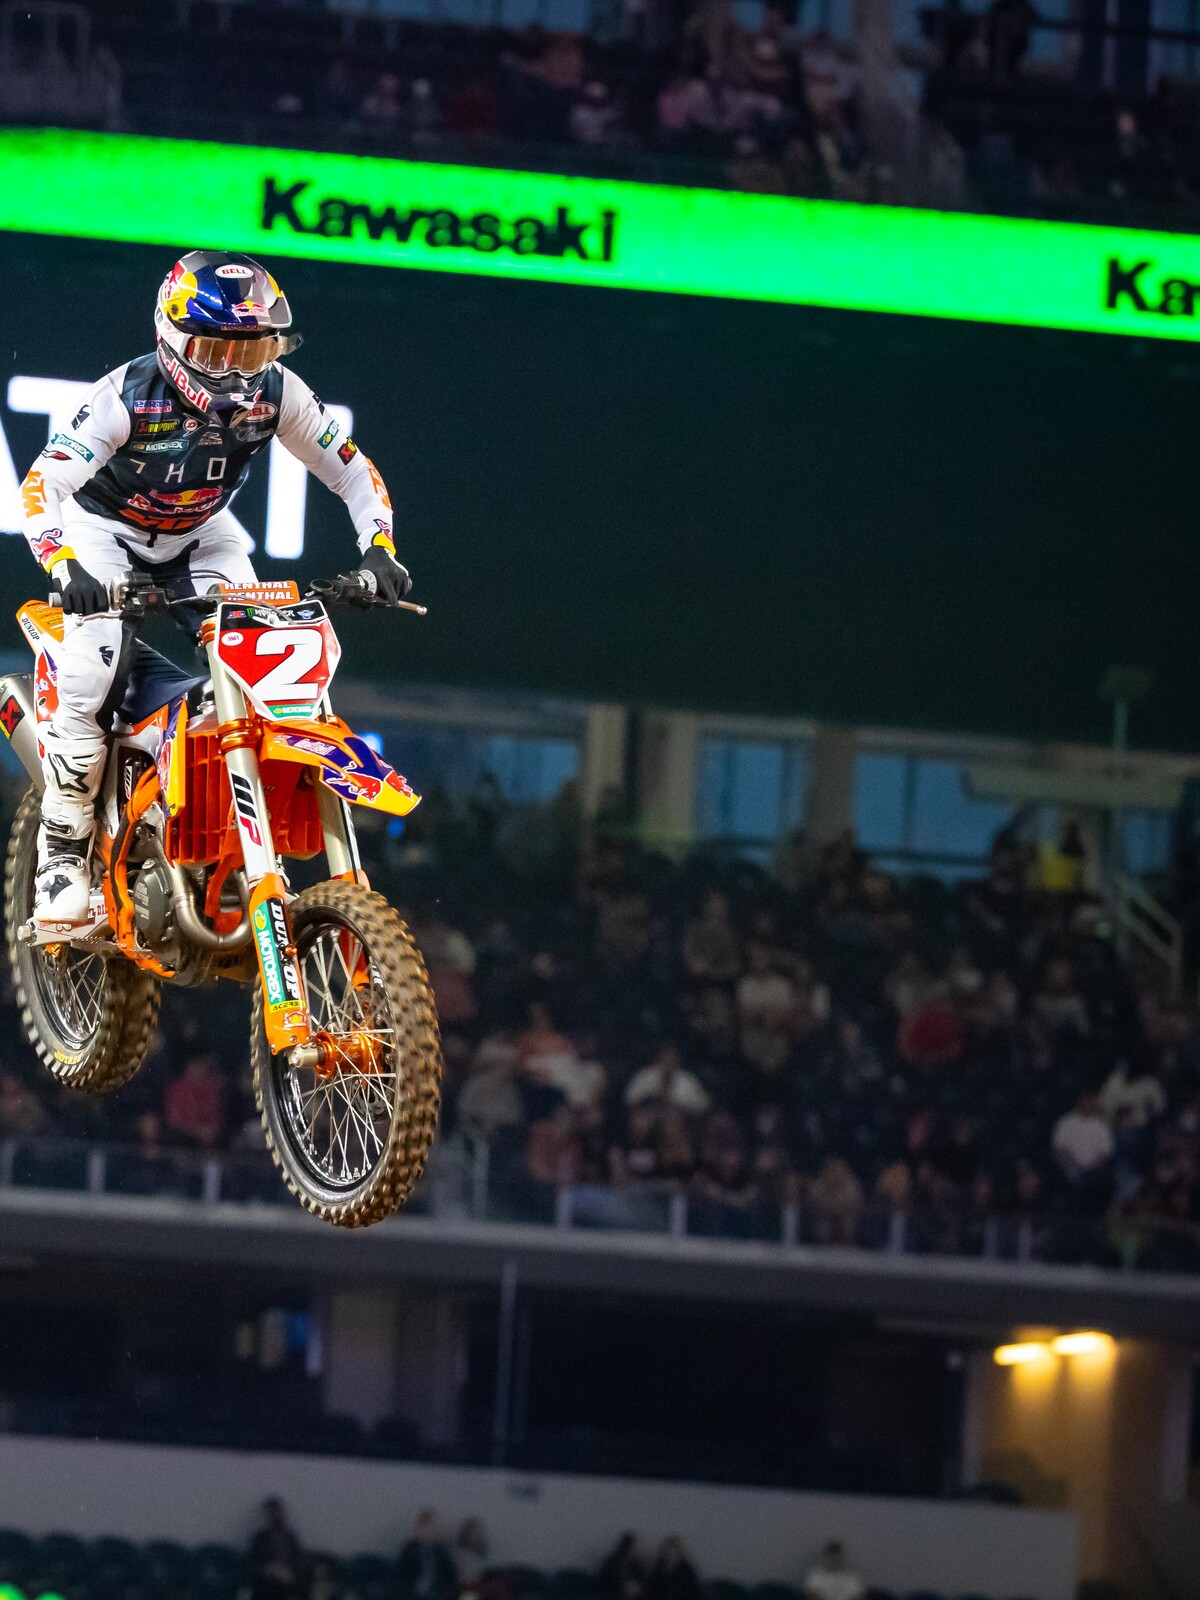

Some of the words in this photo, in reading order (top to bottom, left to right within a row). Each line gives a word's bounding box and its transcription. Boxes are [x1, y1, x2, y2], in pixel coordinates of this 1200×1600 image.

[261, 177, 616, 262] Kawasaki
[221, 268, 249, 276] BELL
[1105, 257, 1200, 317] Ka
[174, 366, 213, 412] Bull
[146, 441, 183, 451] MOTOREX
[21, 470, 48, 519] KTM
[224, 581, 292, 590] RENTHAL
[21, 617, 40, 640] DUNLOP
[251, 628, 323, 701] 2
[257, 930, 282, 1003] MOTOREX
[271, 902, 300, 999] DUNOP
[273, 1001, 305, 1011] ACERB
